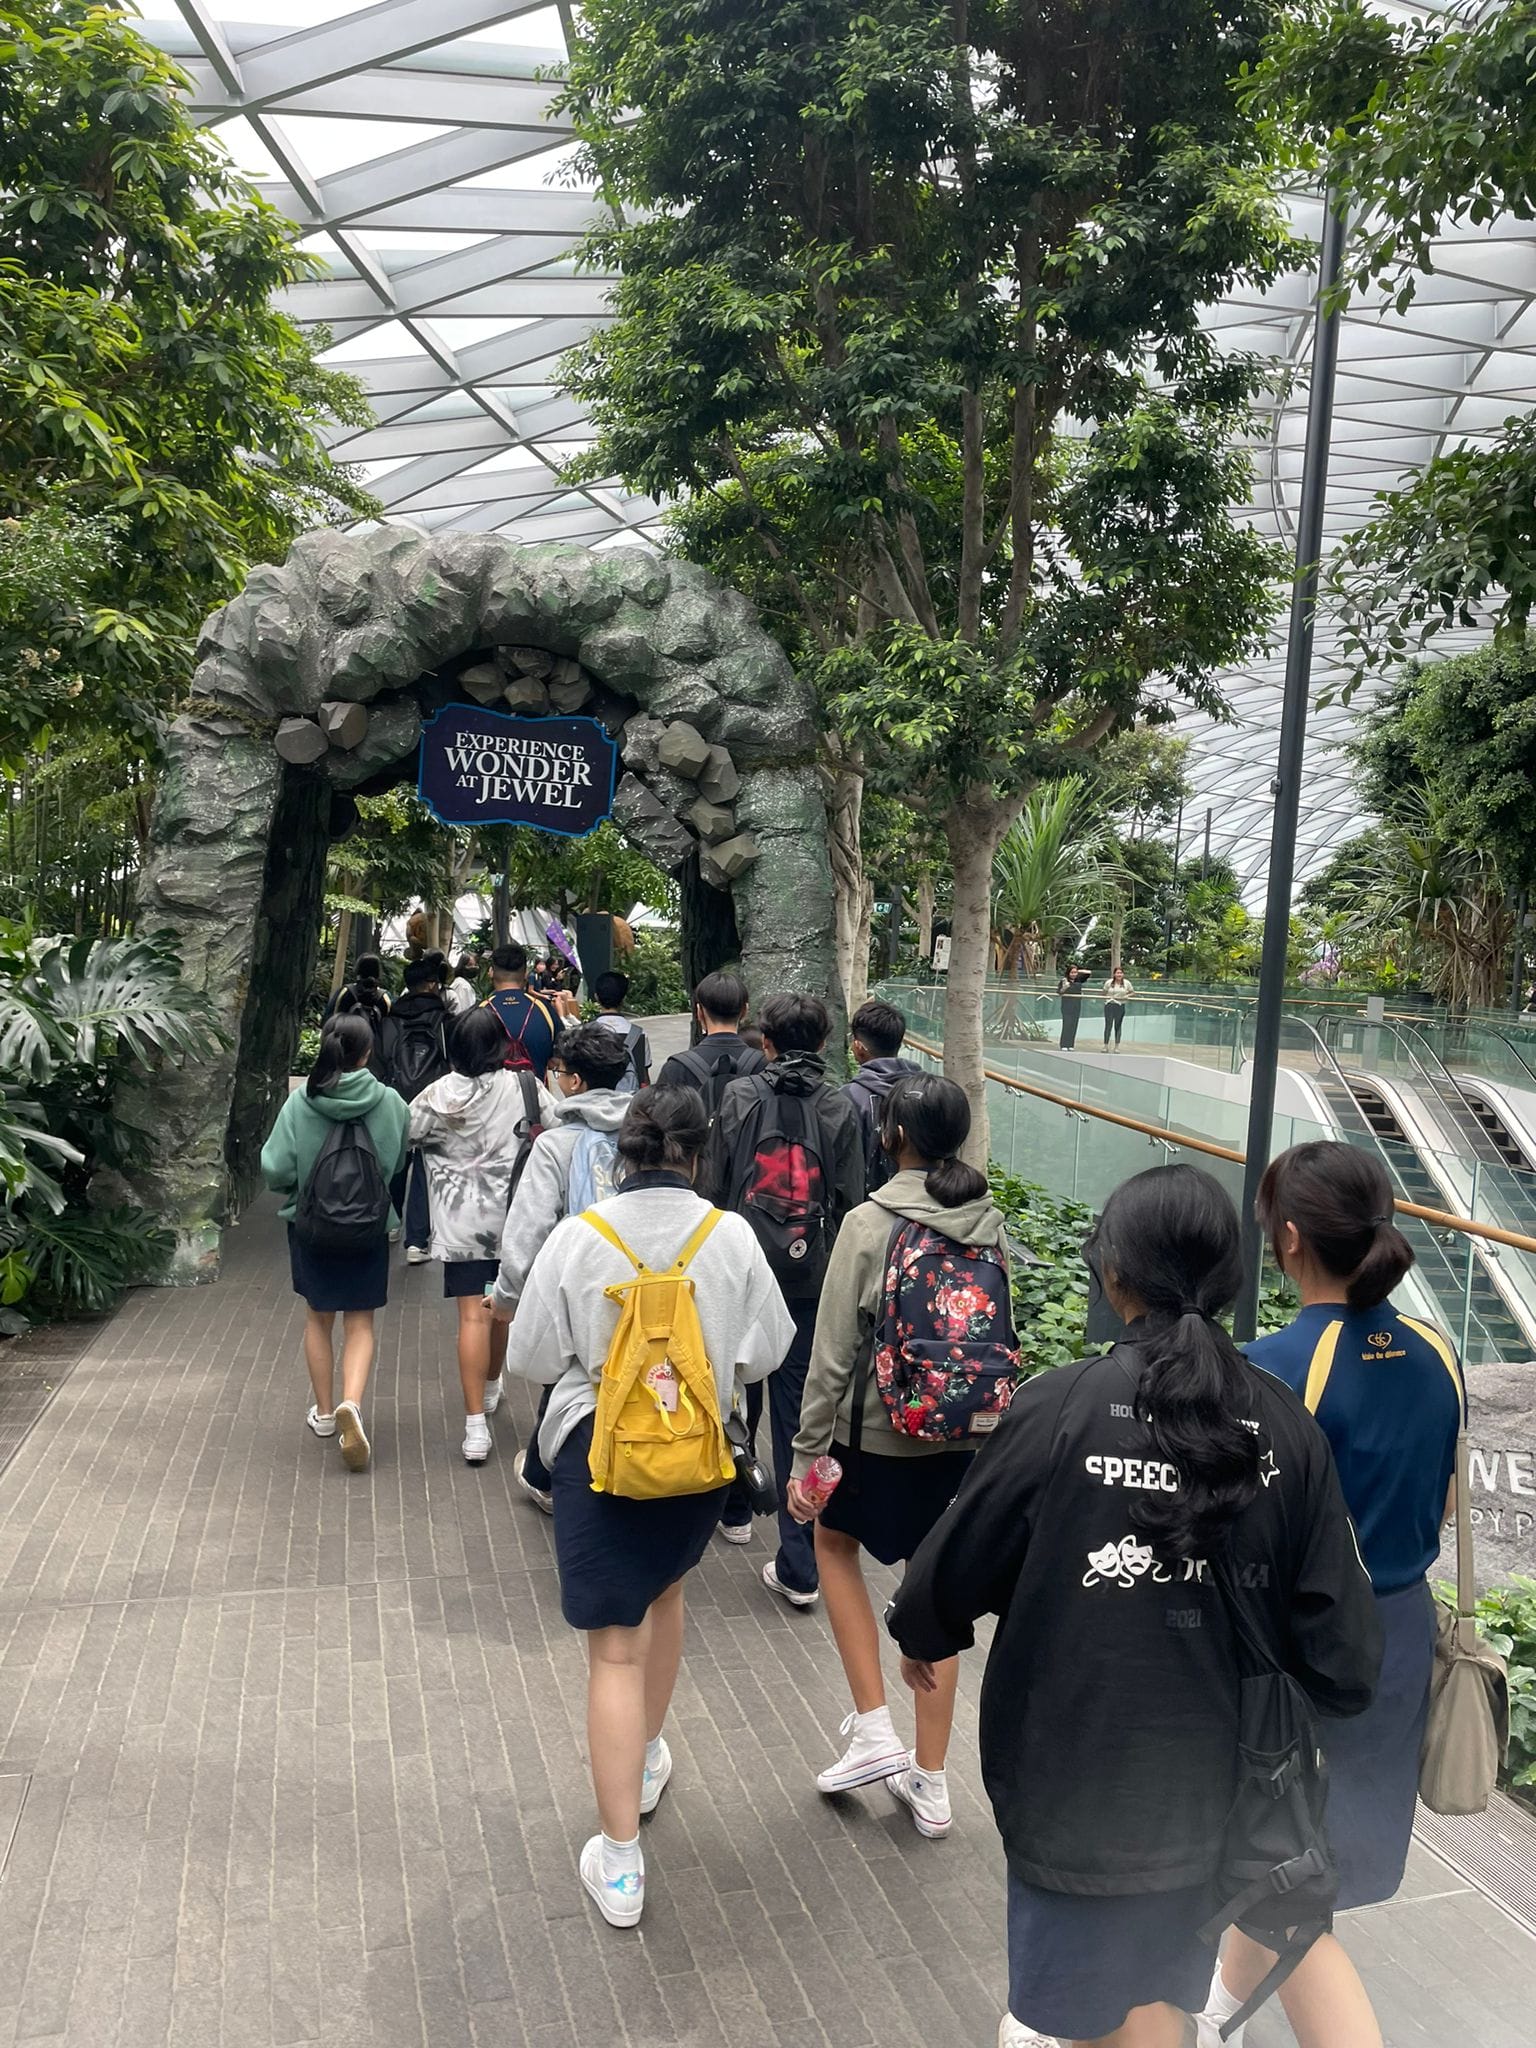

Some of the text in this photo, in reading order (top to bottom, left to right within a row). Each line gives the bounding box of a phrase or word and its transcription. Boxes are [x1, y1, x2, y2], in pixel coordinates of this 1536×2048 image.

[455, 732, 585, 762] EXPERIENCE
[444, 747, 593, 786] WONDER
[455, 774, 583, 809] AT JEWEL
[1085, 1455, 1180, 1493] SPEEC
